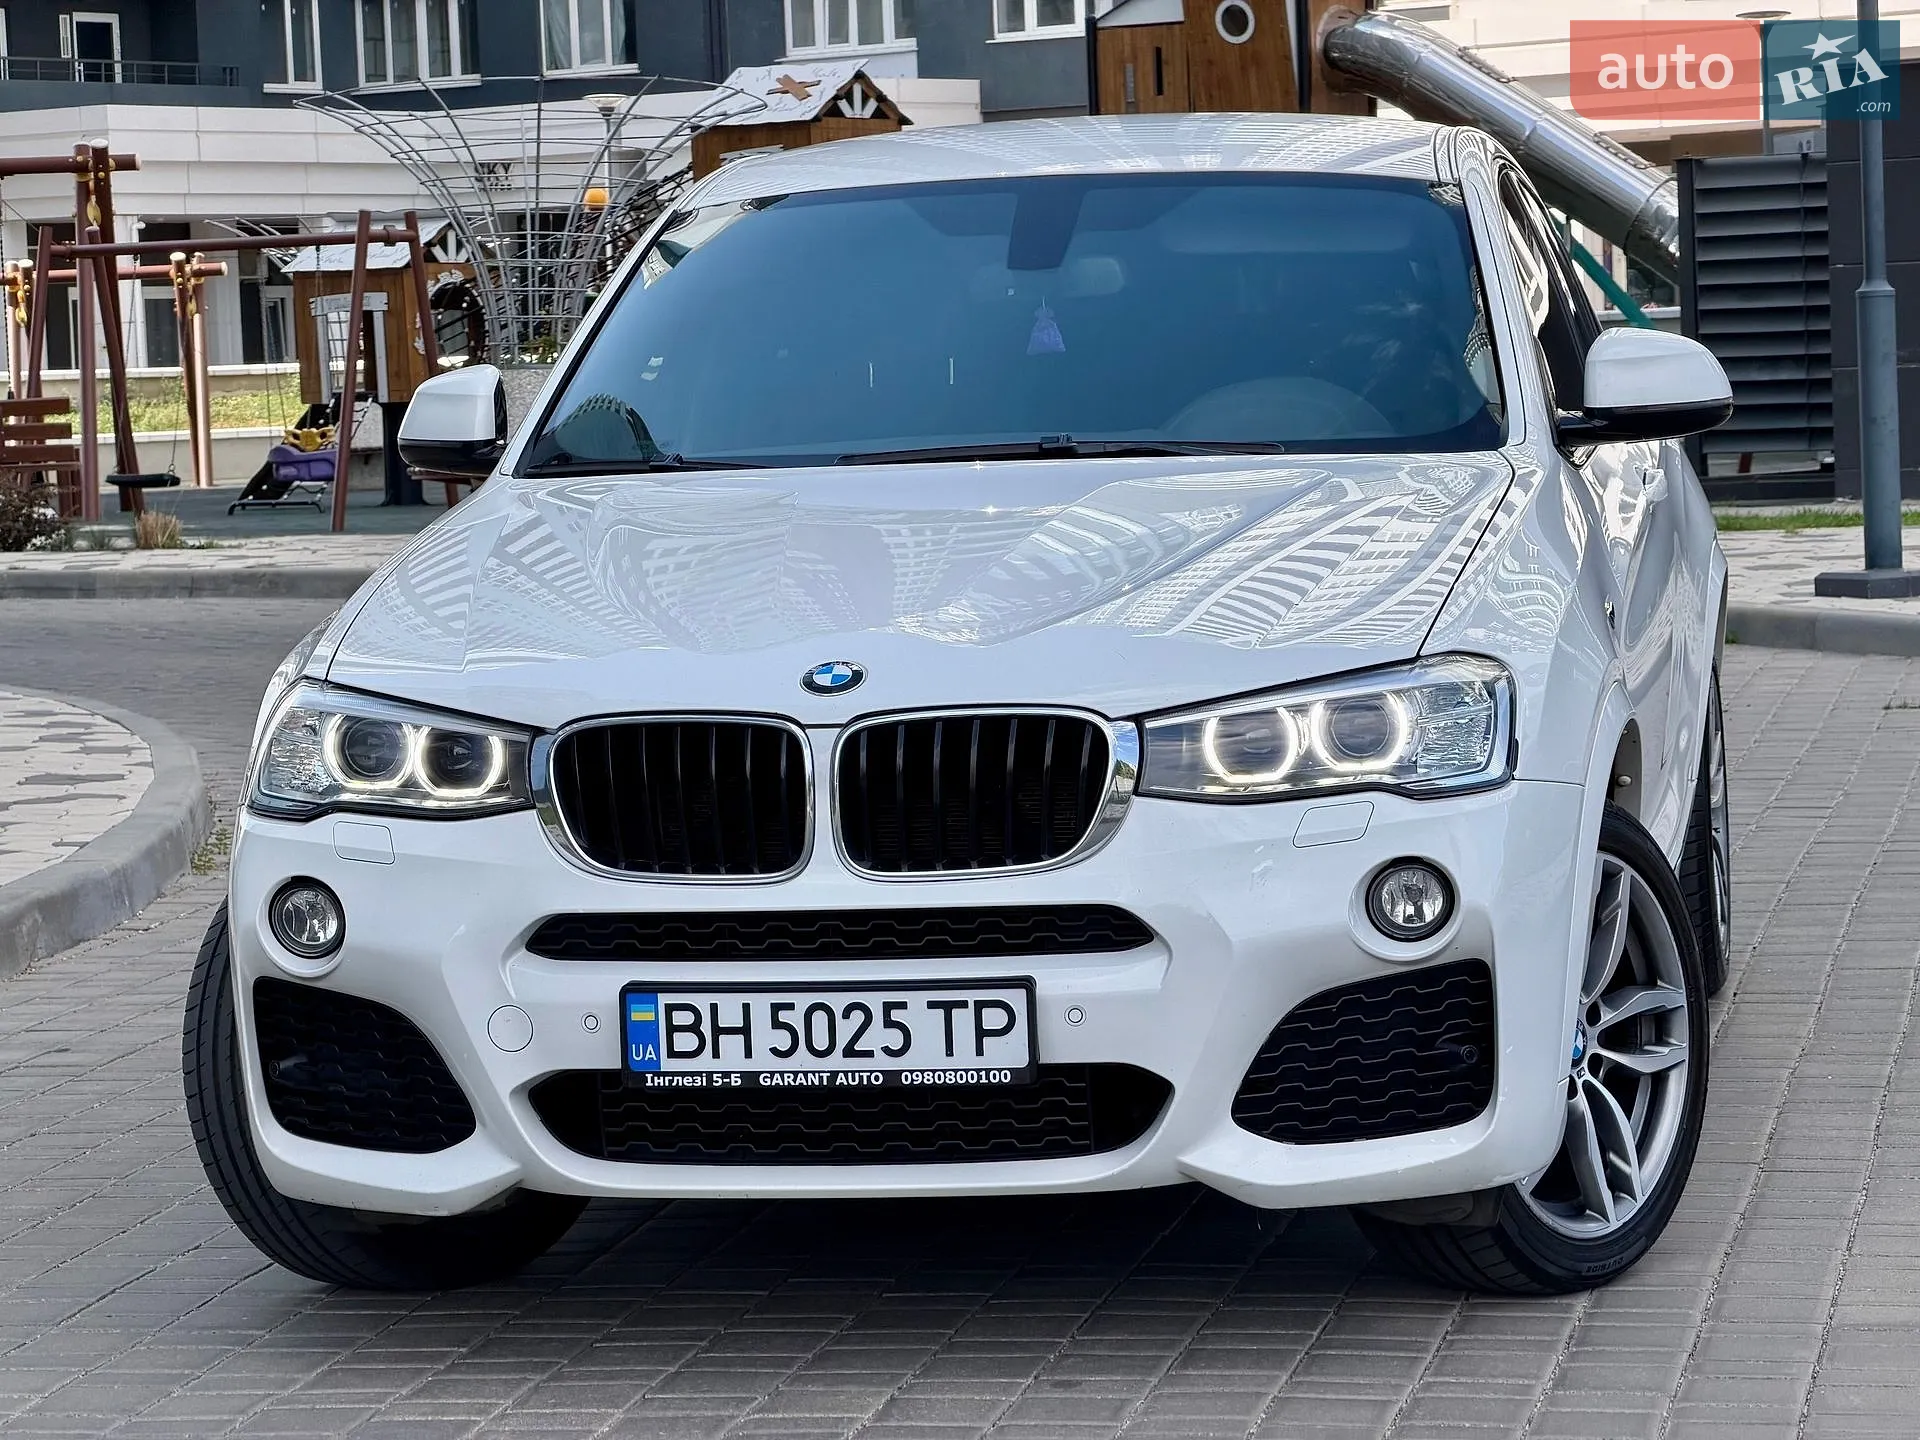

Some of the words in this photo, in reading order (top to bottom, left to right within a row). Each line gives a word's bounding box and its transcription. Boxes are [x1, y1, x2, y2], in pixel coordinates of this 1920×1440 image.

[664, 1002, 753, 1060] BH
[768, 1001, 912, 1059] 5025
[926, 999, 1017, 1058] TP
[632, 1043, 657, 1061] UA
[712, 1073, 742, 1087] 5-Б
[758, 1072, 831, 1086] GARANT
[835, 1071, 884, 1086] AUTO
[901, 1070, 1011, 1085] 0980800100
